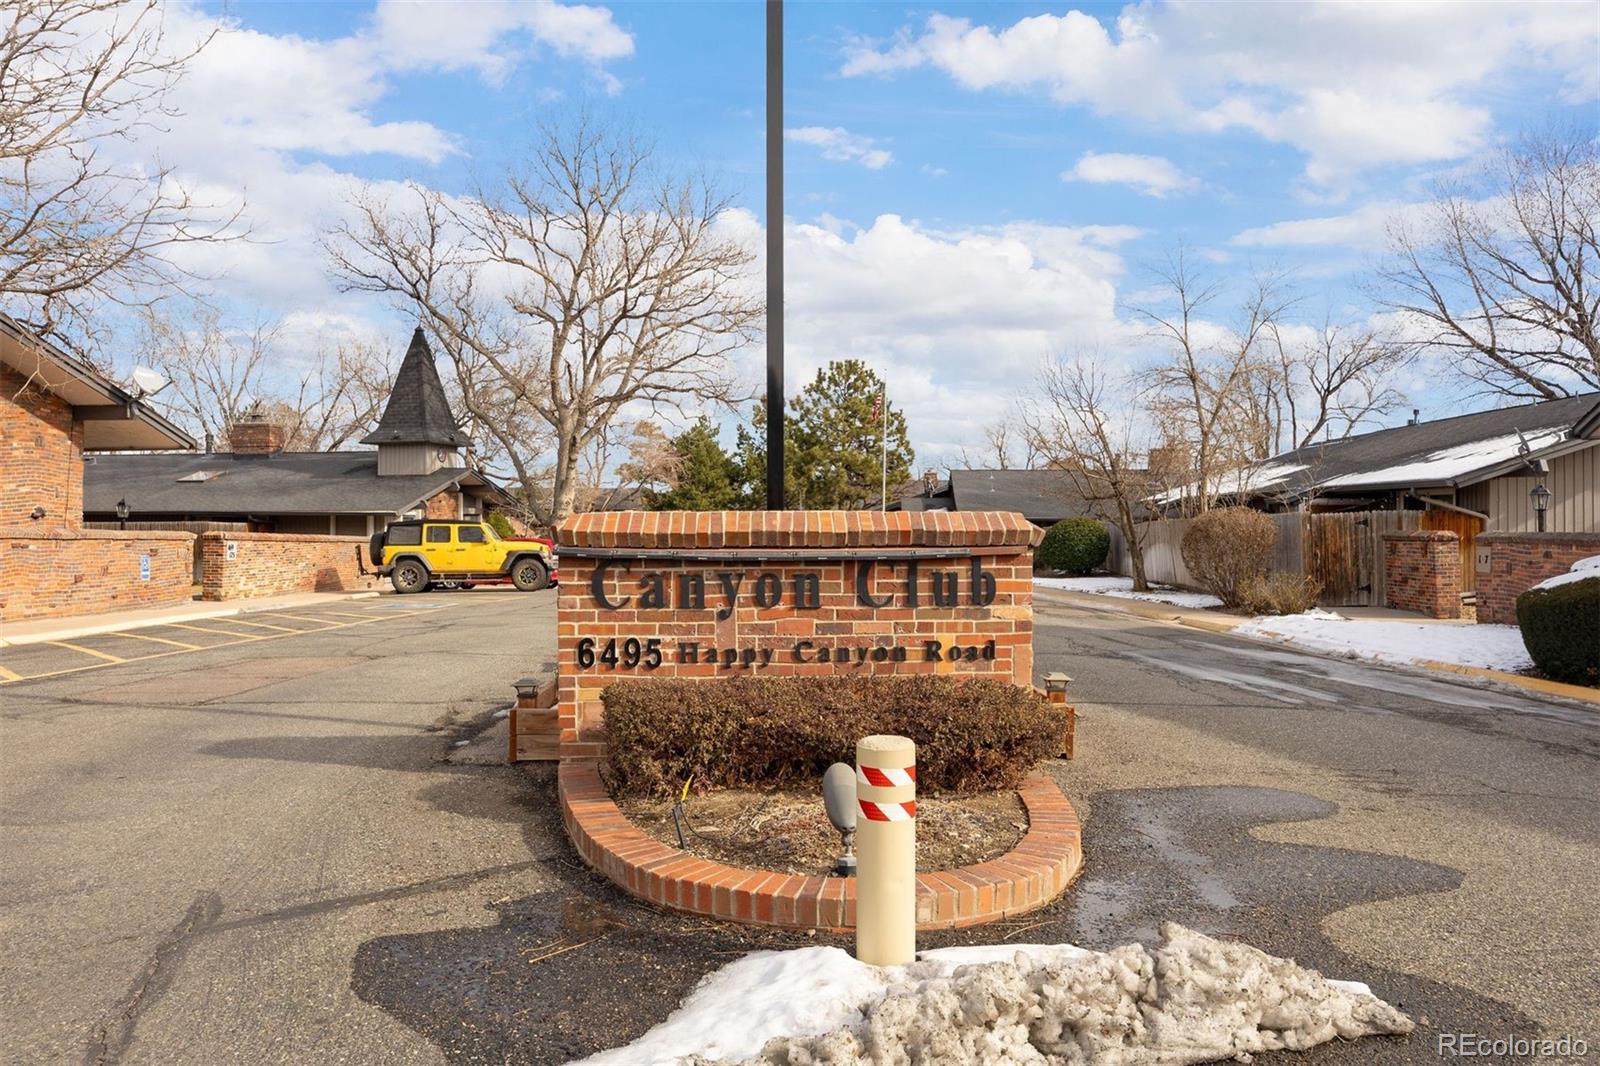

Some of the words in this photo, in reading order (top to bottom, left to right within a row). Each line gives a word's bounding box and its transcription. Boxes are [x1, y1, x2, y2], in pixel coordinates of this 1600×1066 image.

[591, 558, 822, 621] Canyon
[856, 555, 997, 608] Club
[576, 636, 663, 670] 6495
[677, 641, 774, 669] Happy
[792, 640, 907, 667] Canyon
[923, 639, 996, 662] Road
